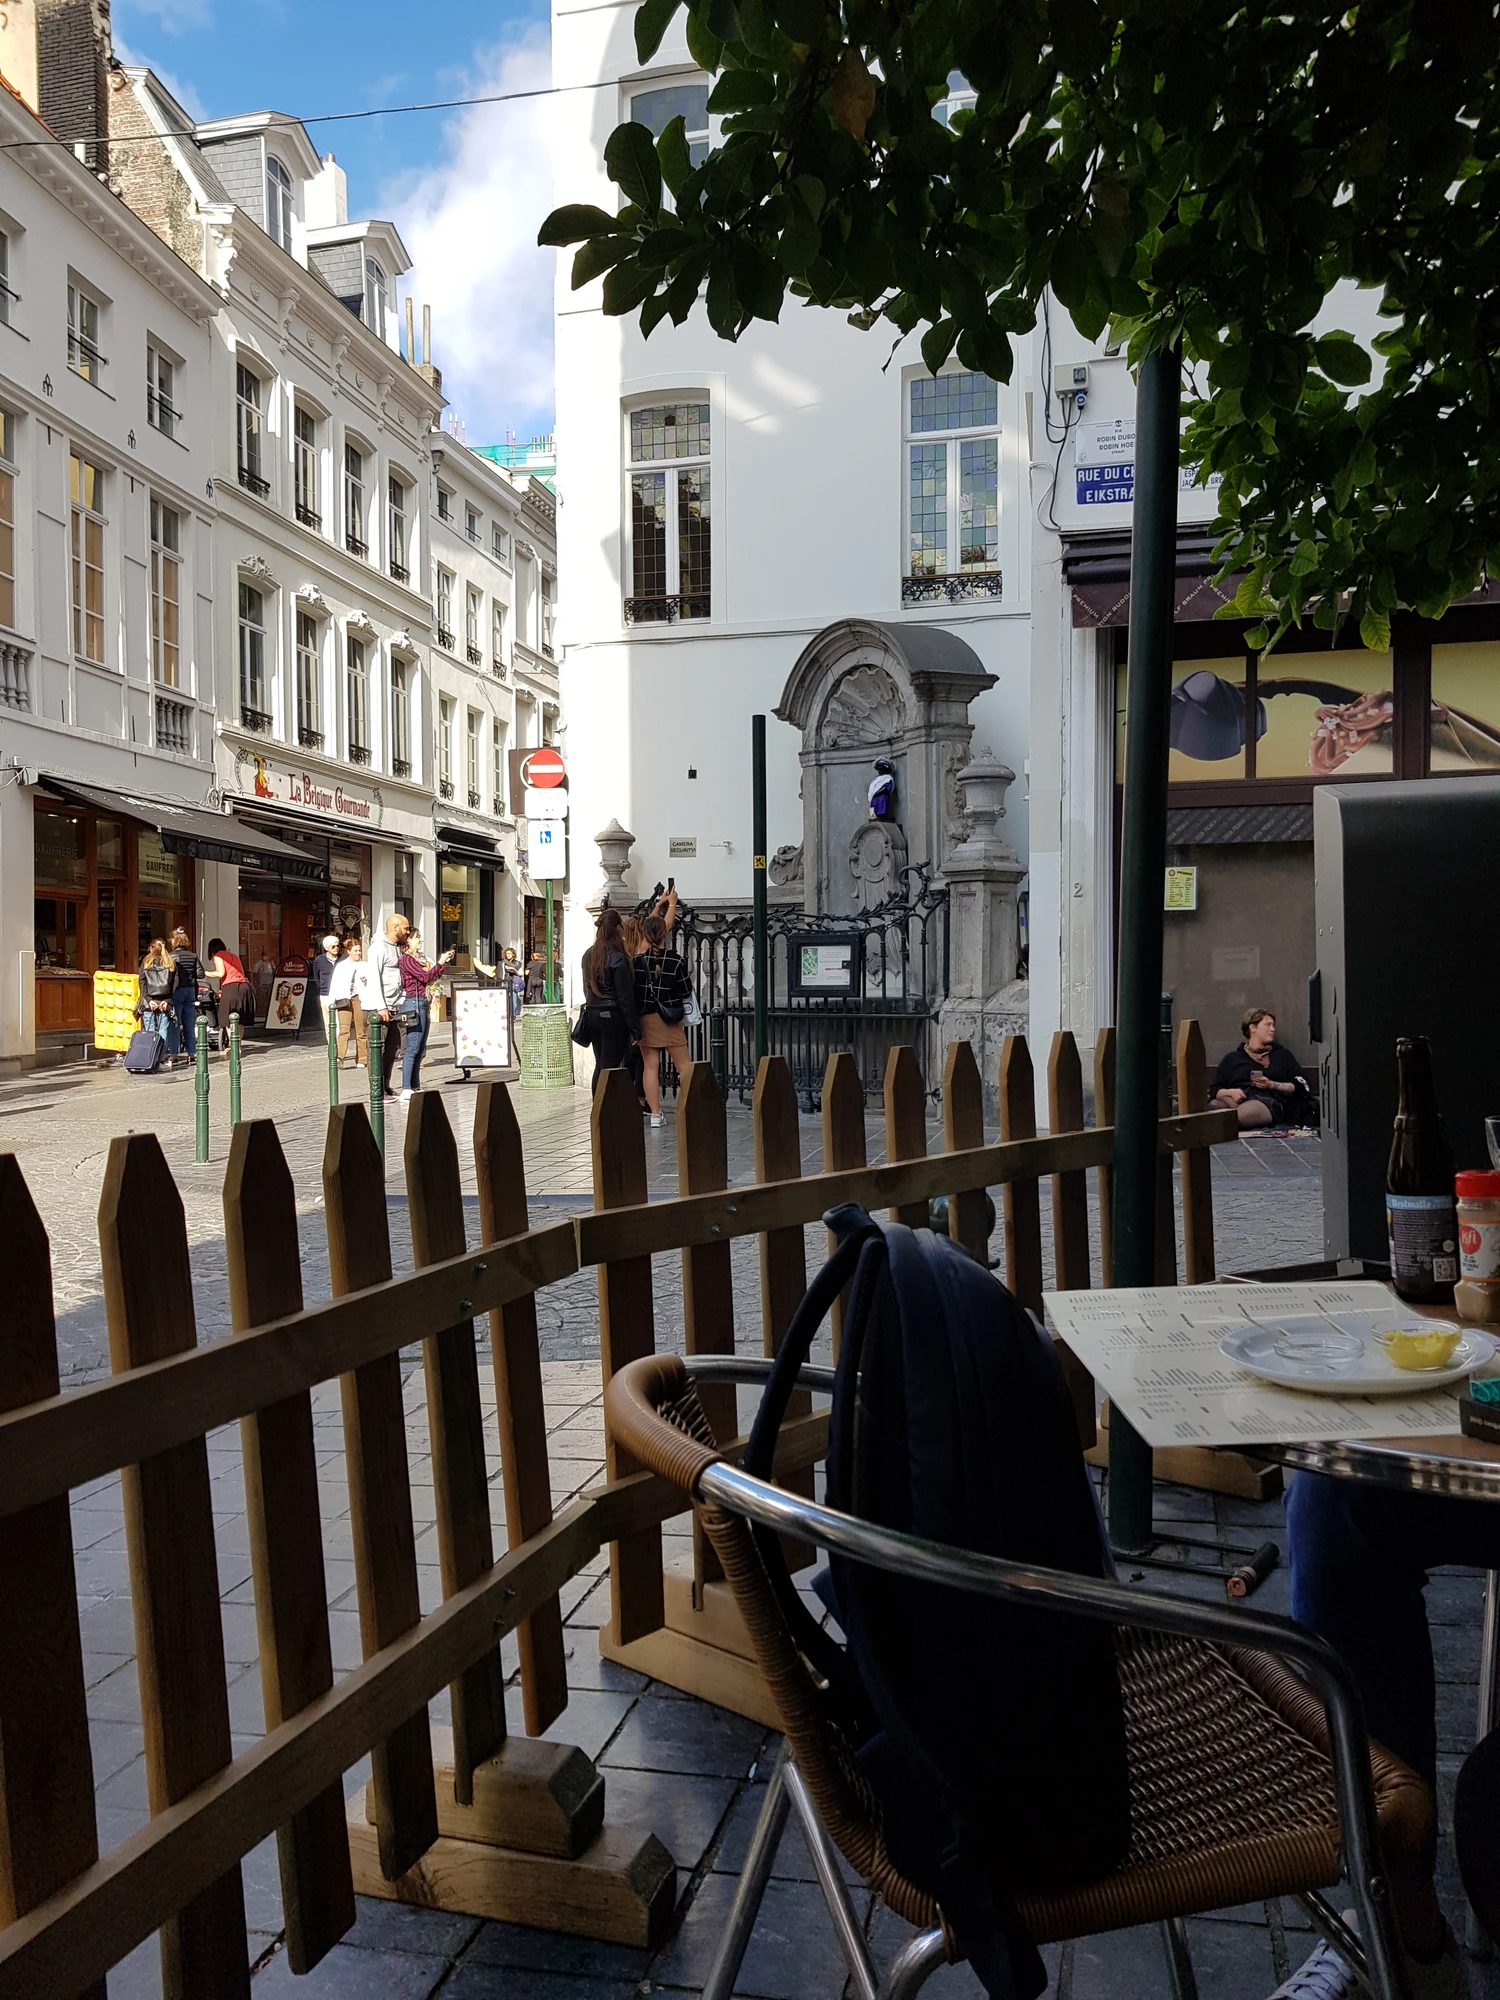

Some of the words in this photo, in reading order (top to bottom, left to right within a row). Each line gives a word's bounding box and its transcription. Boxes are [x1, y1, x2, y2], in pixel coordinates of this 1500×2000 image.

[1096, 435, 1117, 443] ROBIN
[1117, 433, 1136, 441] DUBO
[1099, 443, 1120, 451] ROBIN
[1120, 441, 1135, 449] HOE
[1077, 469, 1101, 482] RUE
[1104, 467, 1120, 480] DU
[1210, 477, 1223, 485] BRE
[1085, 487, 1134, 503] EIKSTRA
[1111, 591, 1131, 612] RUDO
[1181, 583, 1204, 607] BRAUN
[1072, 593, 1100, 619] PREMIUM
[288, 773, 302, 802] La
[302, 772, 333, 813] Belgique
[334, 786, 370, 819] Gourmande
[35, 842, 79, 859] GAUFRERIE
[1073, 882, 1083, 898] 2
[1461, 1229, 1477, 1245] isfi
